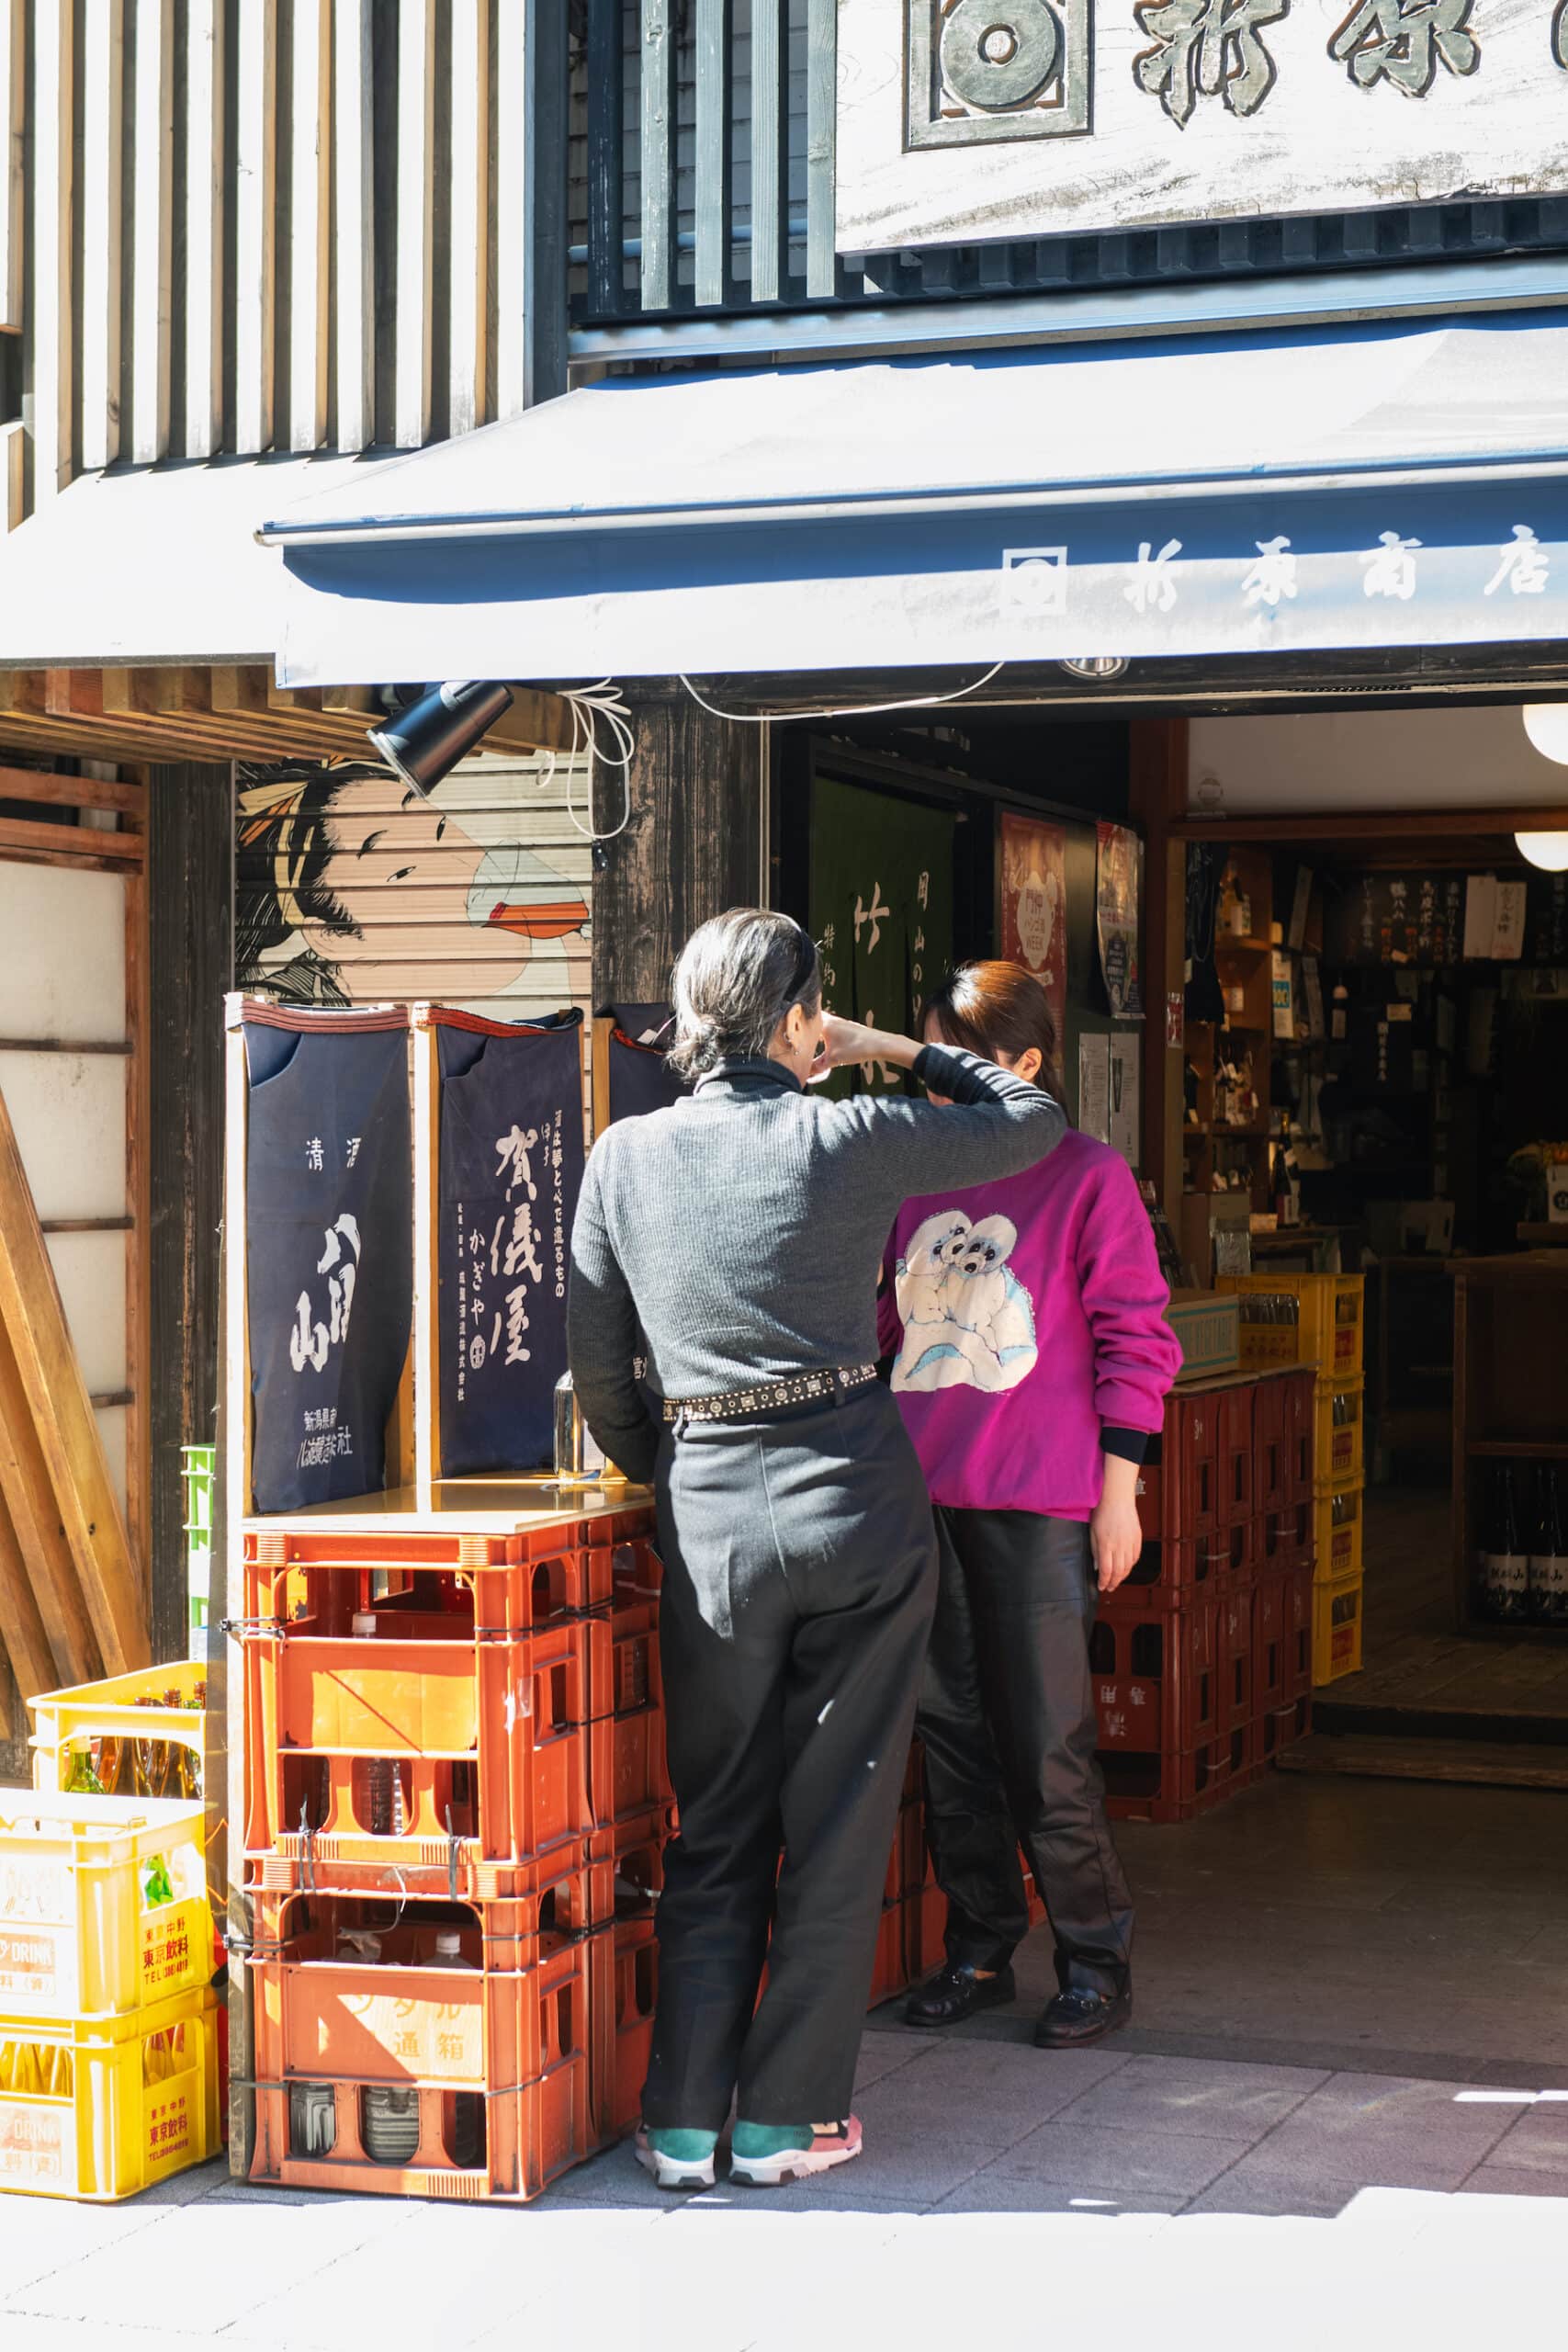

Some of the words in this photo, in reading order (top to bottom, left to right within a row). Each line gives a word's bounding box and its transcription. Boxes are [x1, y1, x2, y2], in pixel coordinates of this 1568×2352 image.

[1124, 525, 1549, 612] 折原商店
[468, 1227, 486, 1326] かぎや
[142, 1934, 189, 1970] 東京飲料
[149, 2112, 189, 2146] 東京飲料
